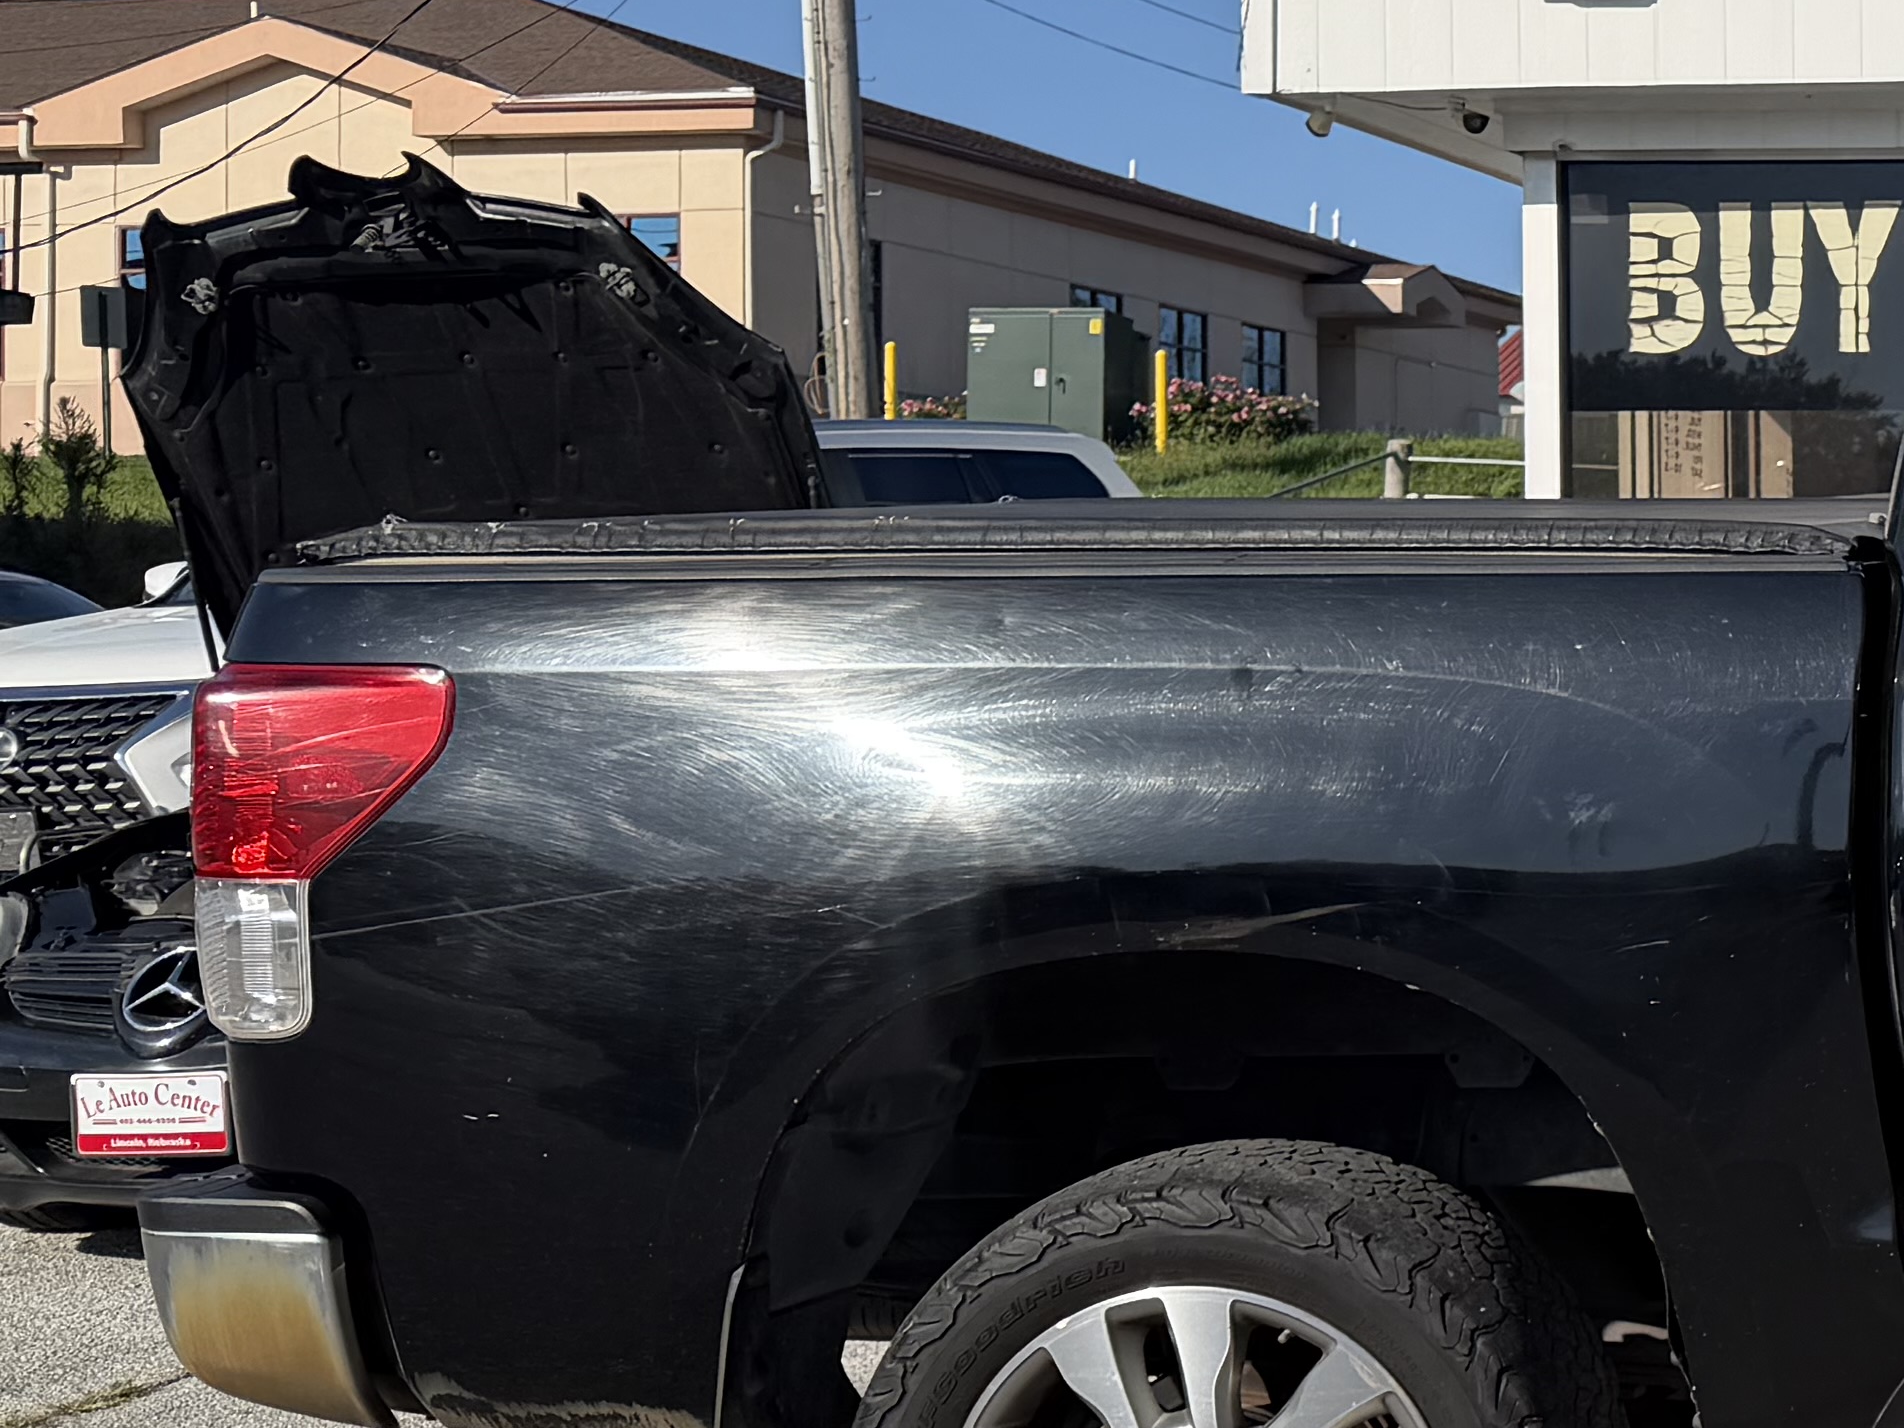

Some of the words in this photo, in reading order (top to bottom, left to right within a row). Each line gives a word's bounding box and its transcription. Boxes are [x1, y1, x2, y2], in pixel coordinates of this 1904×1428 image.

[1627, 199, 1903, 356] BUY
[80, 1096, 106, 1119] Le
[108, 1086, 149, 1111] Auto
[154, 1082, 221, 1118] Center
